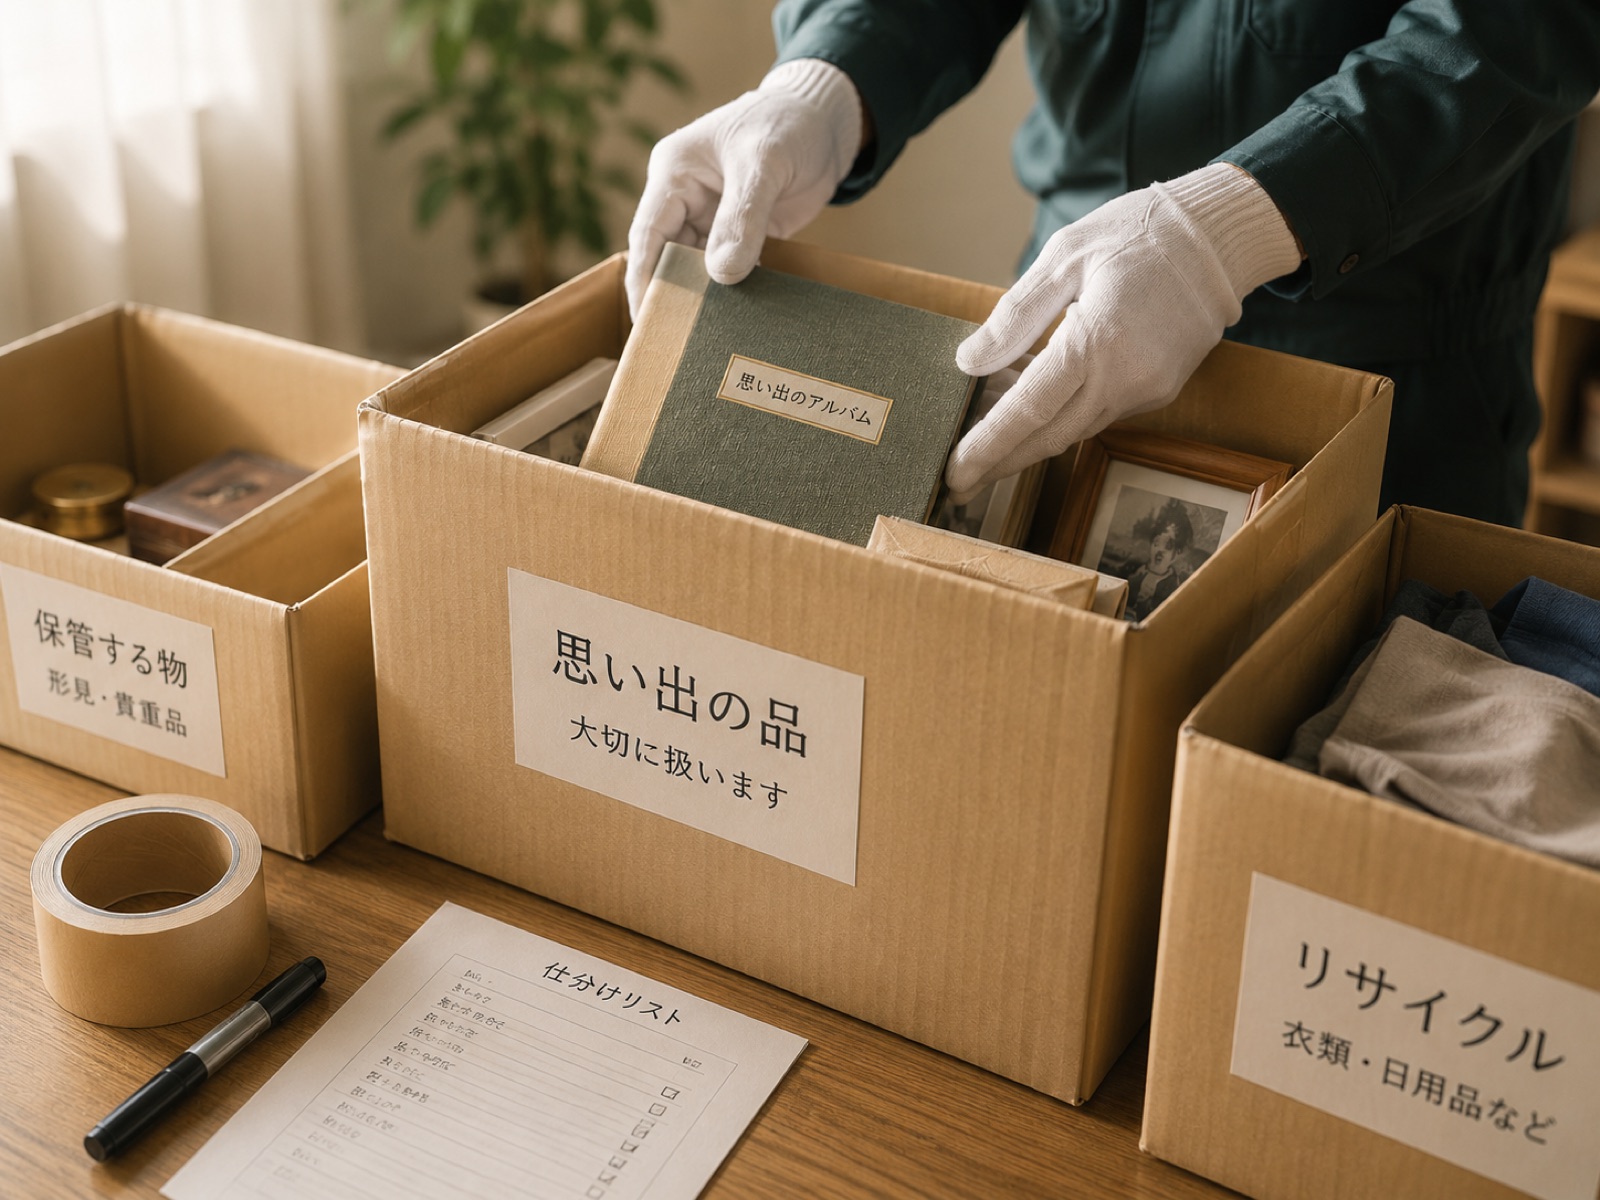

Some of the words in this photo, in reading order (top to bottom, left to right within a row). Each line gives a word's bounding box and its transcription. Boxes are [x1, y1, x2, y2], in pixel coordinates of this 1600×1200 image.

[736, 372, 871, 425] 思い出のアルバム
[34, 608, 188, 689] 保管する物
[47, 668, 188, 738] 形見・貴重品
[552, 629, 807, 758] 思い出の品
[570, 715, 788, 809] 大切に扱います
[541, 961, 683, 1026] 仕分けリスト
[1298, 941, 1566, 1072] リサイクル
[1281, 1020, 1557, 1146] 衣類・日用品など
